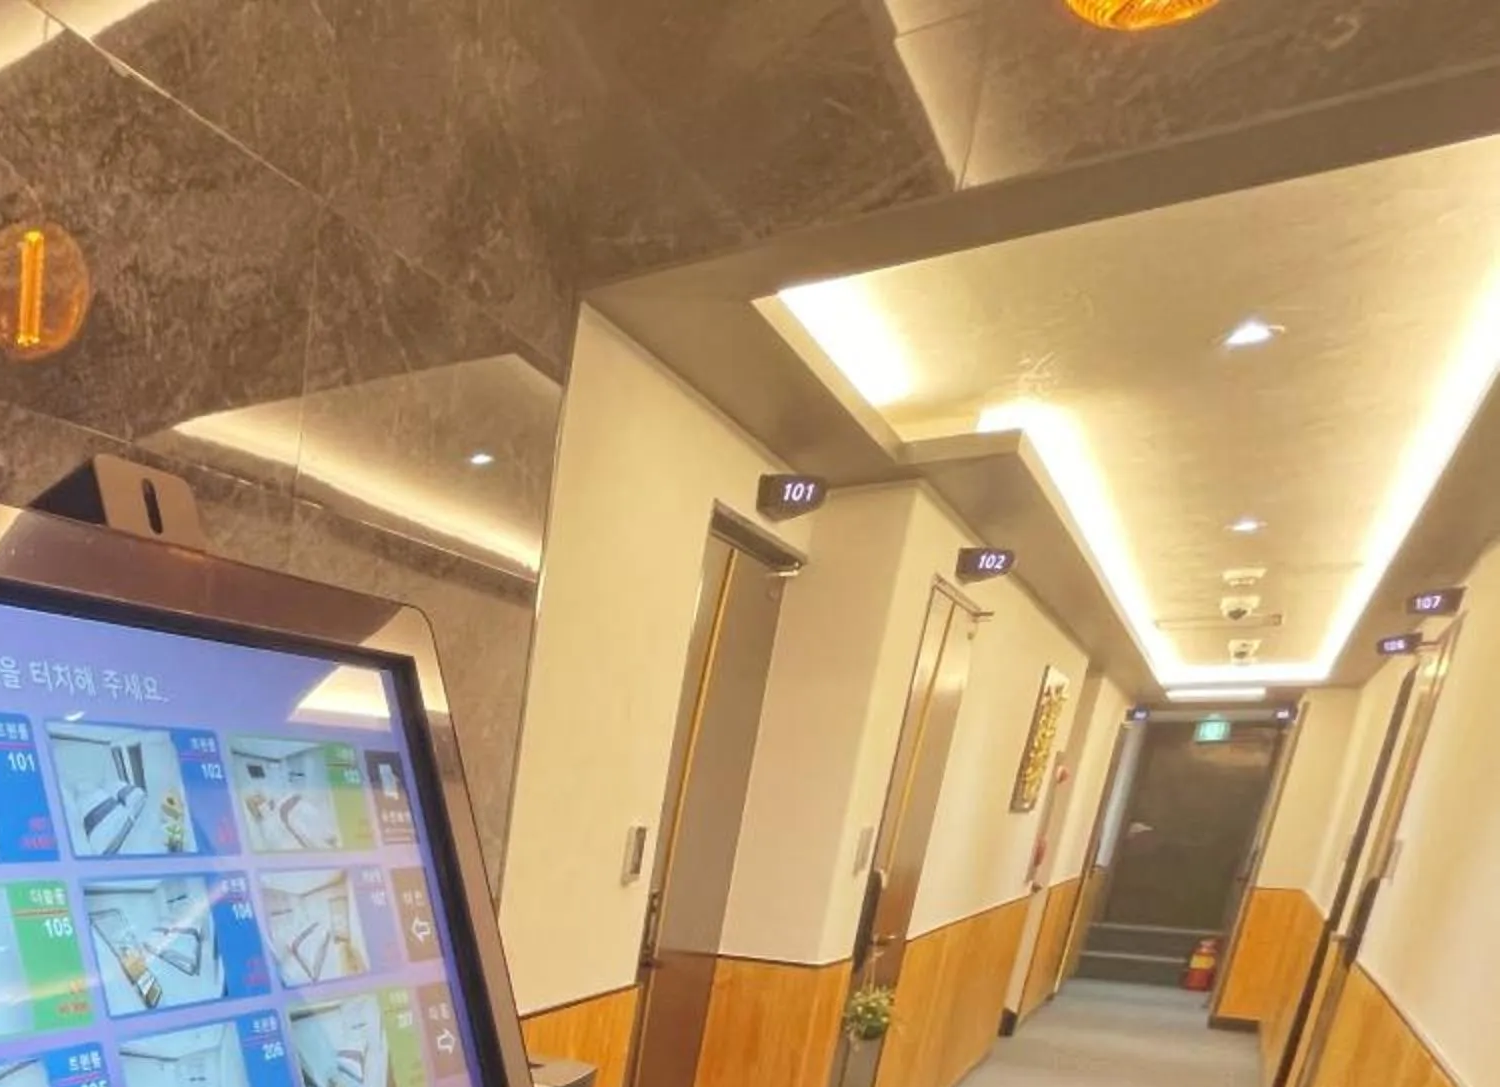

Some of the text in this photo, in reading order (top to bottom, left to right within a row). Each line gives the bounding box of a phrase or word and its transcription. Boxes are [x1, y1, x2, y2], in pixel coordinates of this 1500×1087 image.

[783, 482, 816, 502] 101
[978, 553, 1006, 570] 102
[1414, 595, 1442, 611] 107
[29, 661, 97, 696] 터치해
[7, 752, 37, 772] 101
[201, 762, 224, 780] 102
[45, 917, 73, 938] 105
